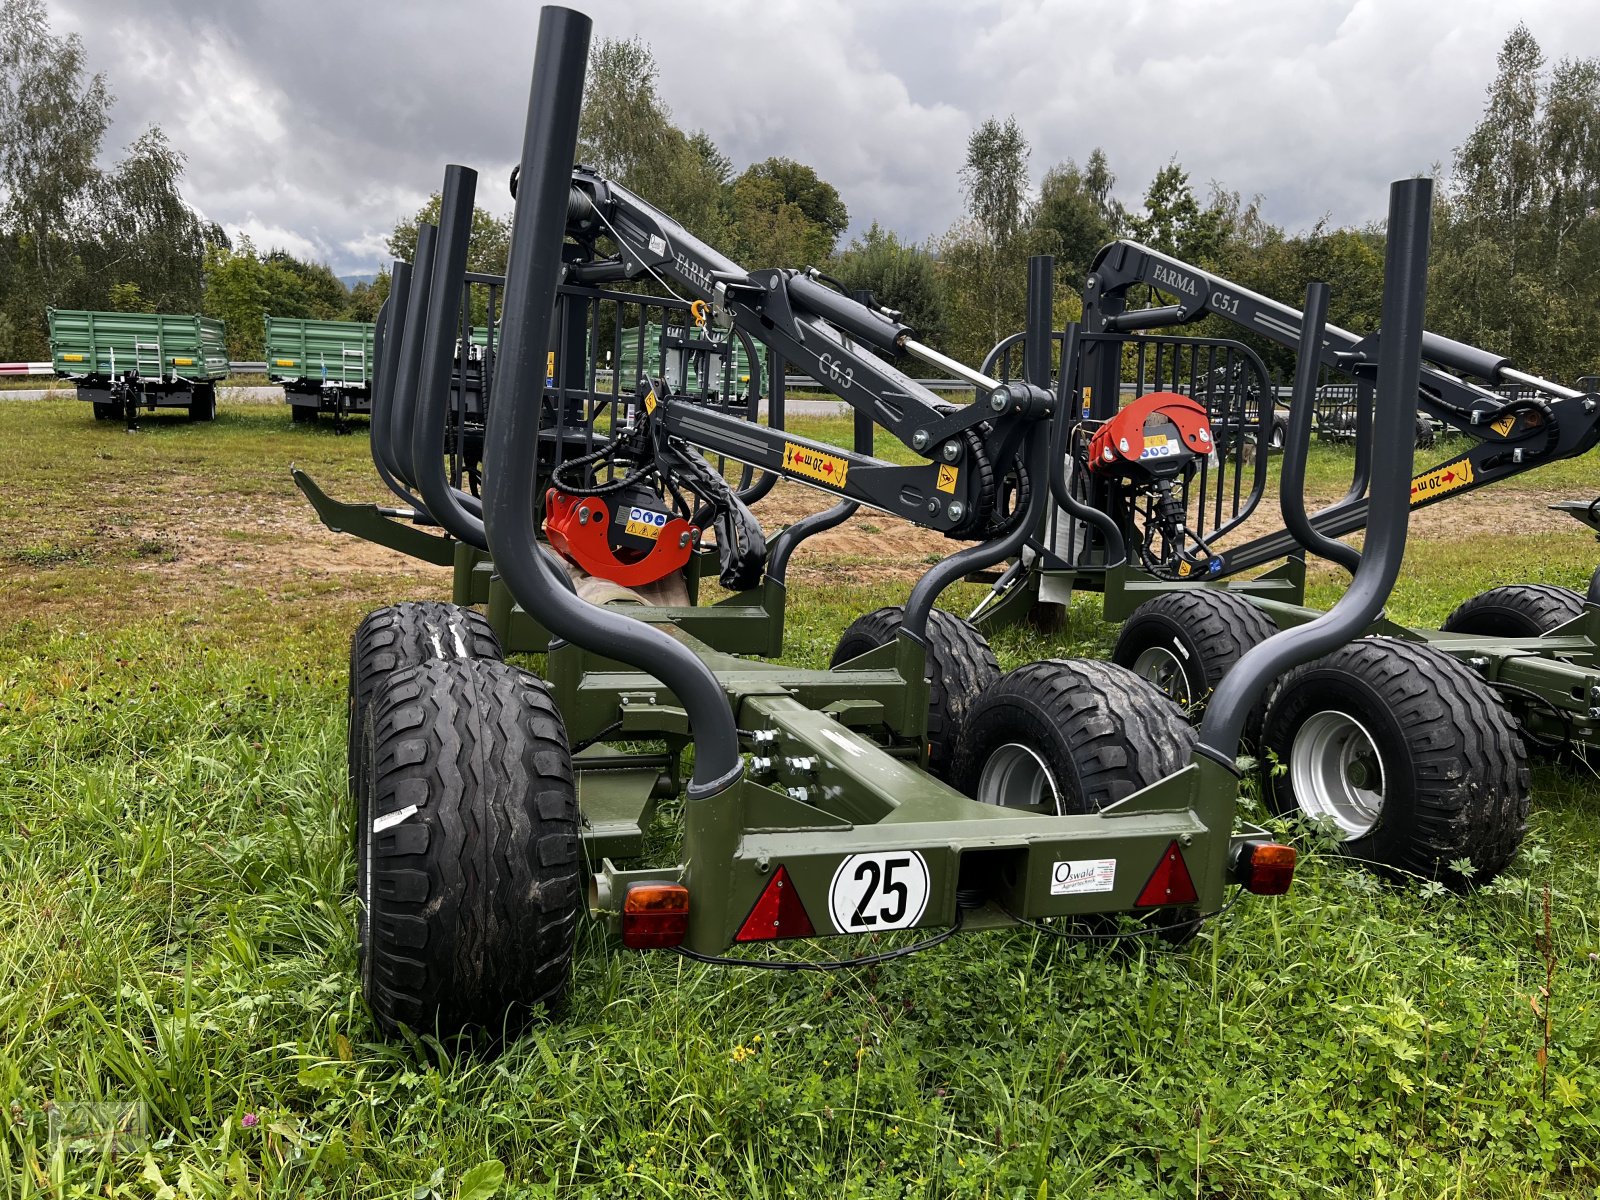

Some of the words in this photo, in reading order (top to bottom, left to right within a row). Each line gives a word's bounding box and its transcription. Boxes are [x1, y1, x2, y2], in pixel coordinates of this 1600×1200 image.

[675, 252, 714, 296] FARM
[1153, 264, 1197, 296] FARMA
[1211, 292, 1240, 315] C5.1
[819, 352, 854, 389] C6.3
[804, 454, 813, 466] m
[813, 457, 824, 472] 20
[1417, 480, 1428, 491] m
[1429, 475, 1442, 489] 20
[1055, 862, 1095, 883] Oswald
[850, 858, 911, 927] 25
